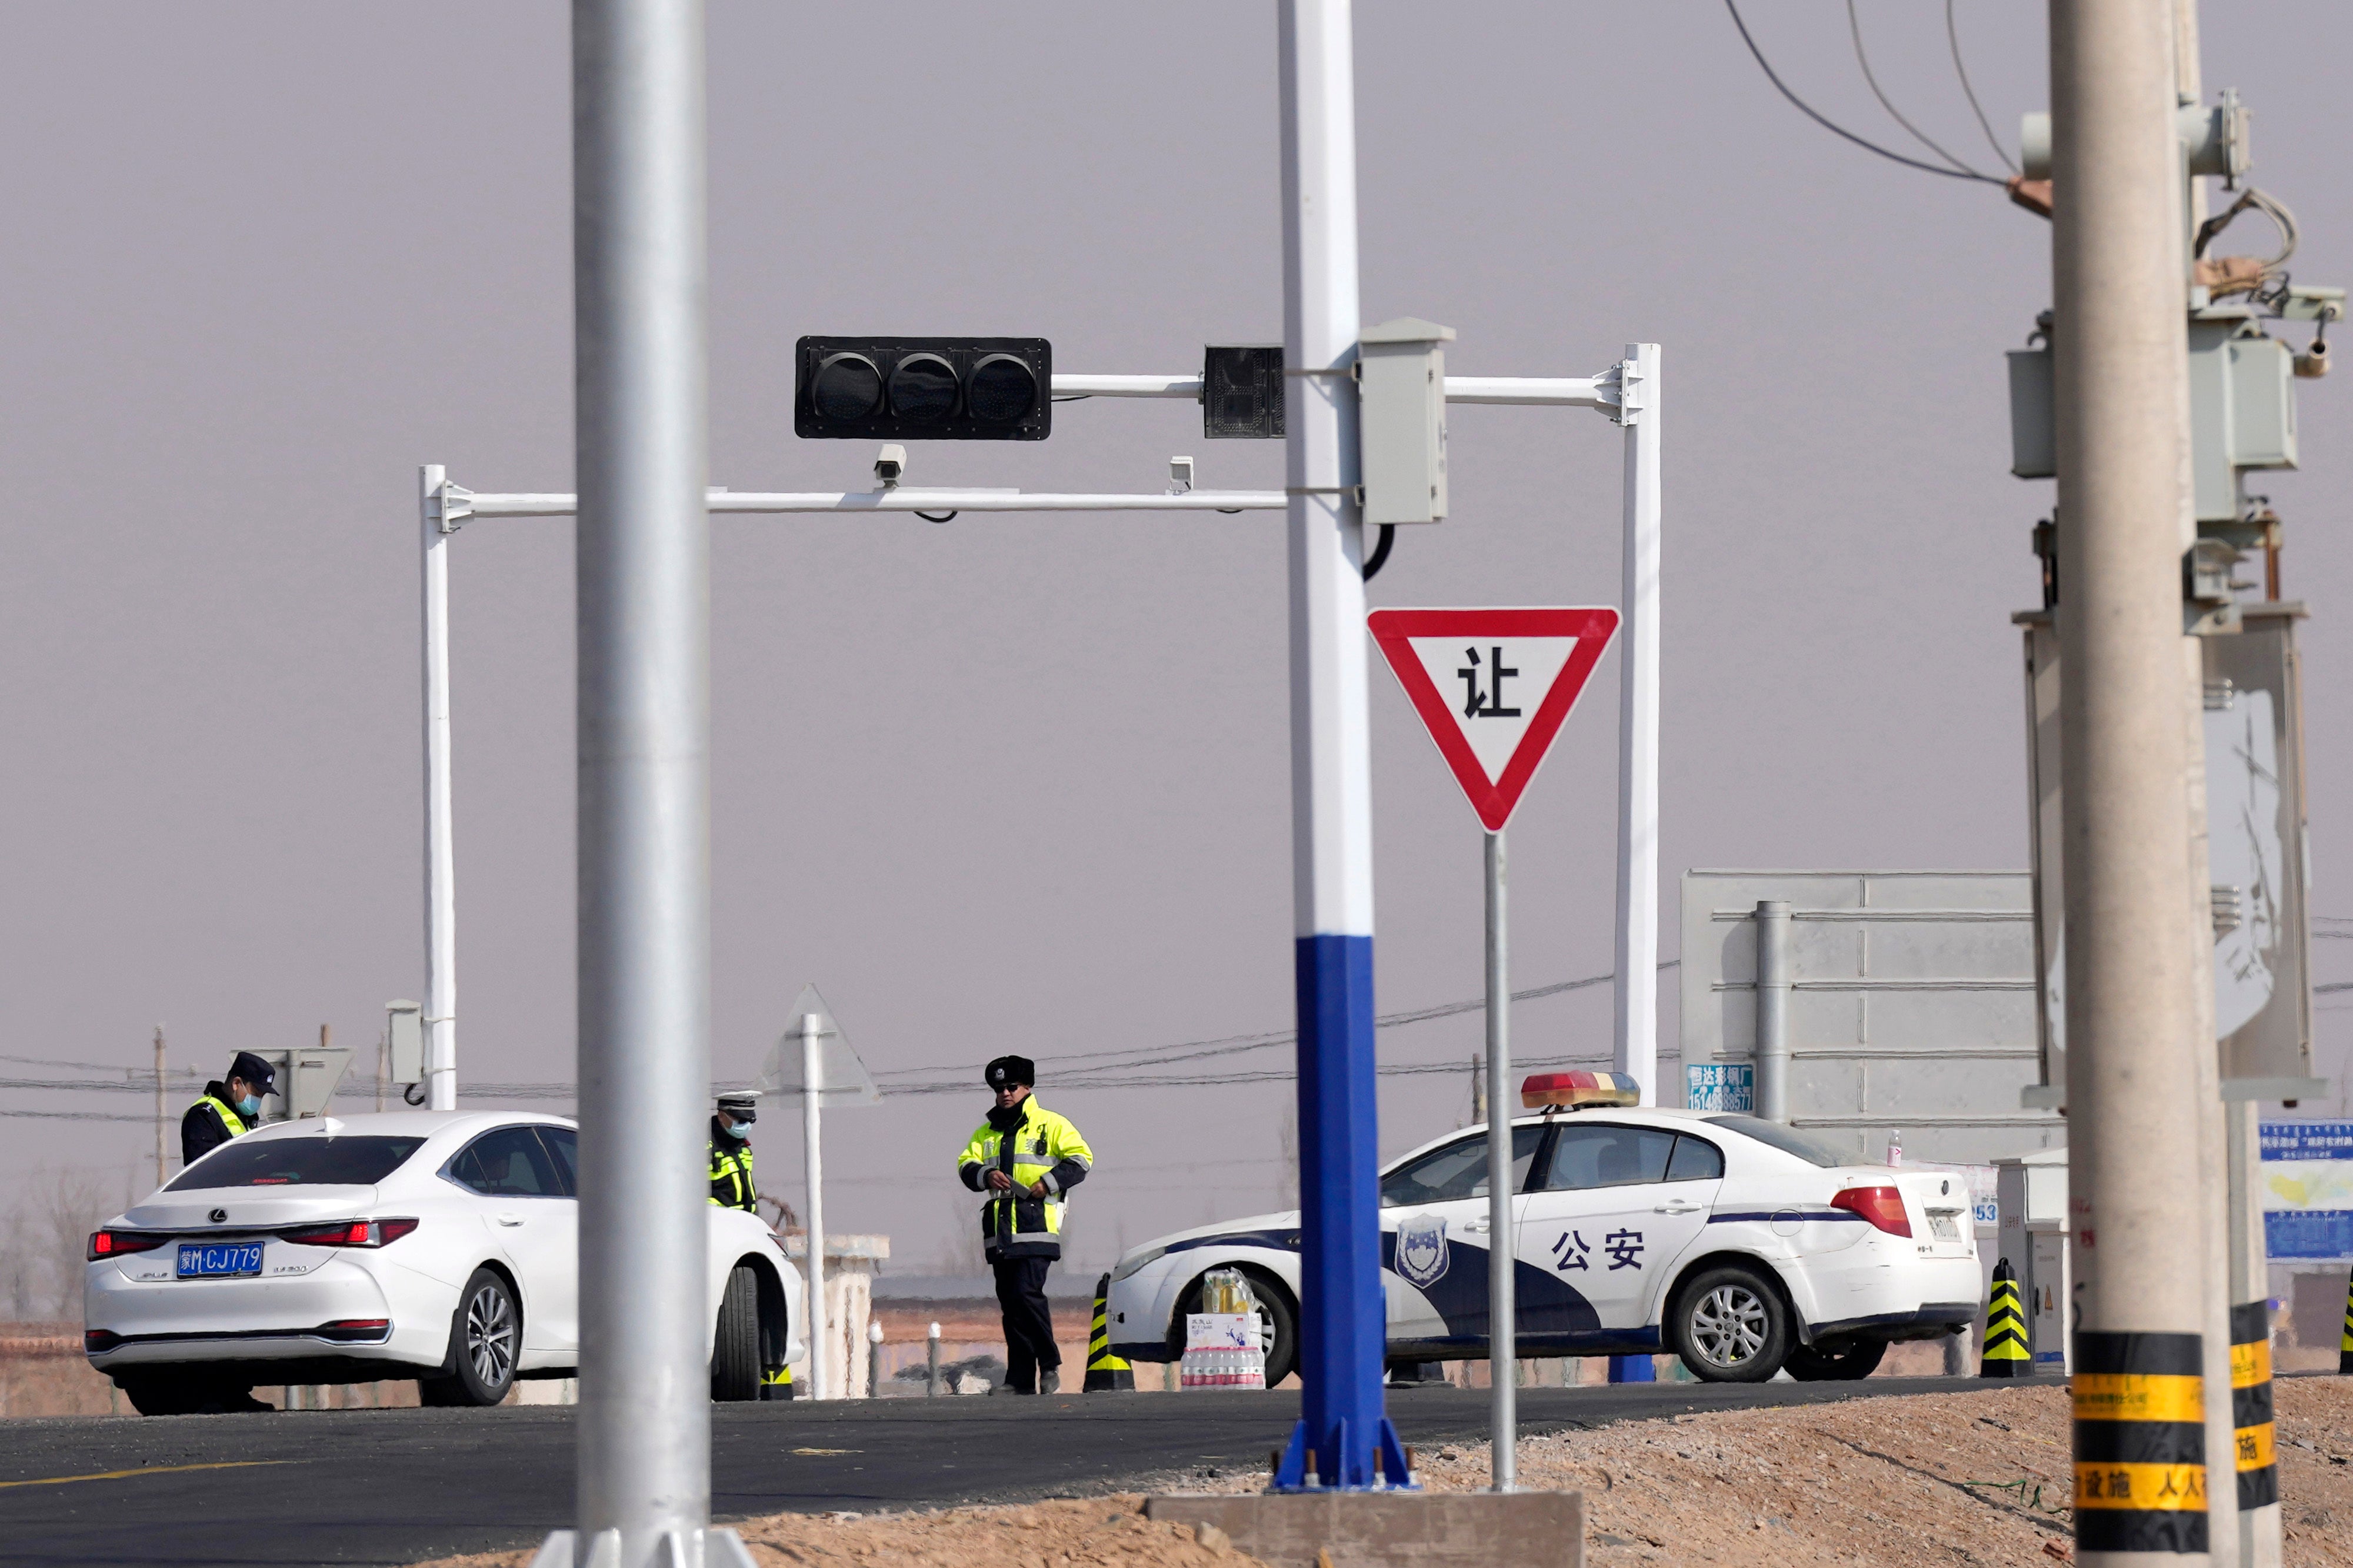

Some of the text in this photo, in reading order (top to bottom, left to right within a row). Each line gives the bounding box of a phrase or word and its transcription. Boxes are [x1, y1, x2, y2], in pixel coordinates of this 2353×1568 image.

[1457, 647, 1521, 719] 让
[1971, 1204, 1997, 1221] 53
[1551, 1228, 1645, 1271] 公安
